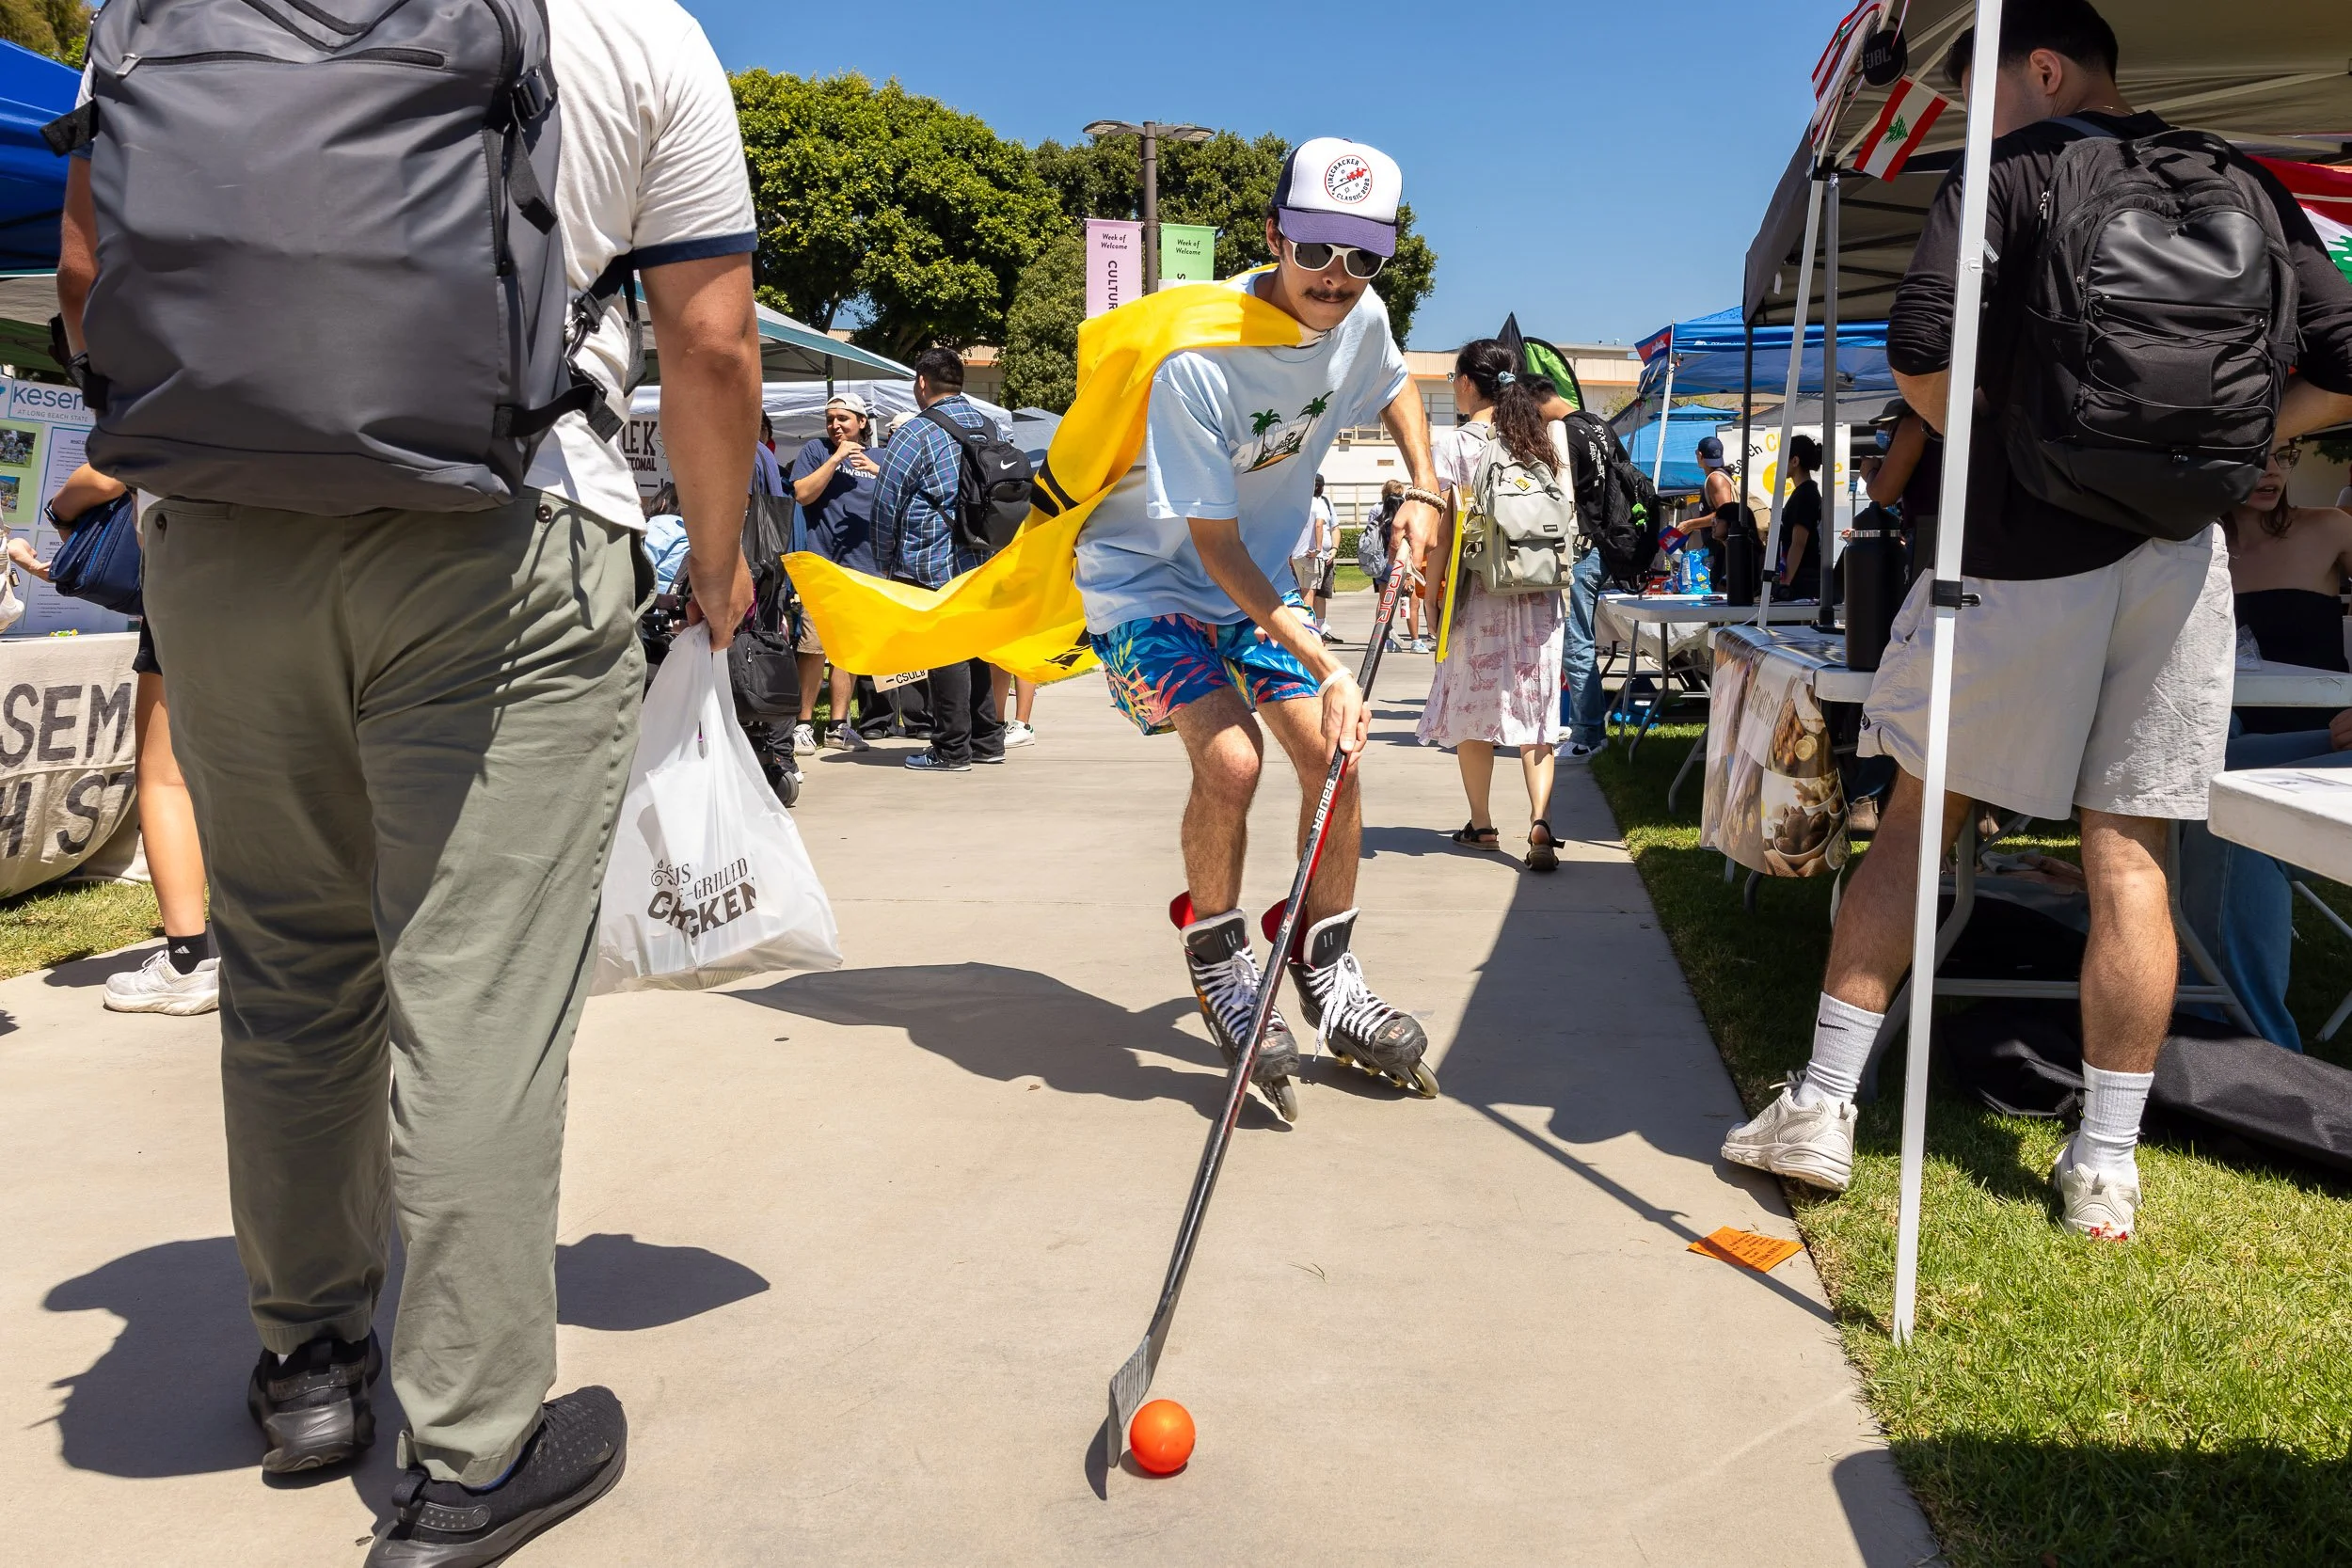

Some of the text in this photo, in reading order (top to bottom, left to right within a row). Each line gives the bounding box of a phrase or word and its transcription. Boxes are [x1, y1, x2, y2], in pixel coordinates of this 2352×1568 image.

[1866, 47, 1891, 69] JBL
[1327, 158, 1359, 188] FIRECRACKER
[1336, 192, 1362, 201] CLASSIC
[1101, 242, 1128, 250] Welcome
[1119, 234, 1127, 244] of
[1175, 247, 1201, 256] Welcome
[1107, 260, 1119, 310] CULTUR
[0, 683, 132, 768] SEM
[1312, 778, 1336, 832] BAUER
[647, 879, 756, 939] CHCKEN
